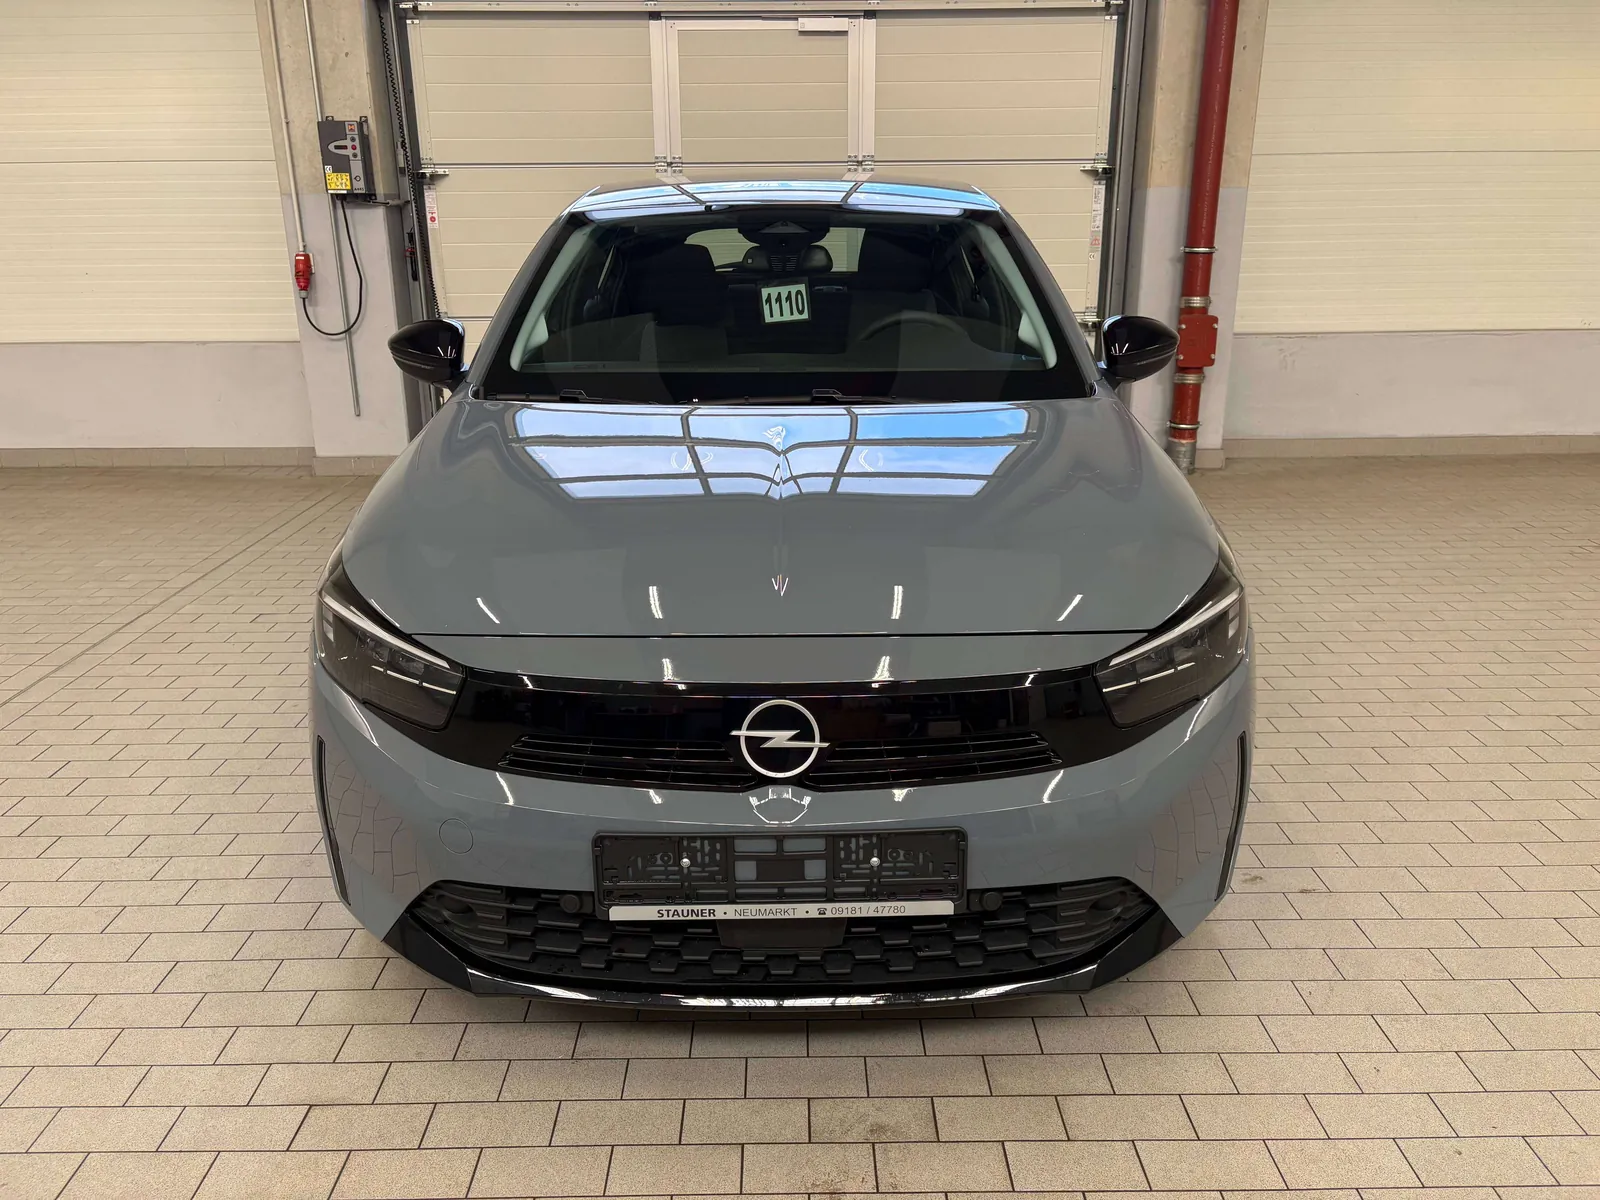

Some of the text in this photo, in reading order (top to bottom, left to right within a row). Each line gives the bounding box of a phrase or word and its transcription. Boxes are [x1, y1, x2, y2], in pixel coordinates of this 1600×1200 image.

[765, 289, 805, 318] 1110
[657, 908, 716, 918] STAUNER
[734, 907, 797, 917] NEUMARKT
[831, 906, 862, 915] 09181
[873, 905, 906, 914] 47780
